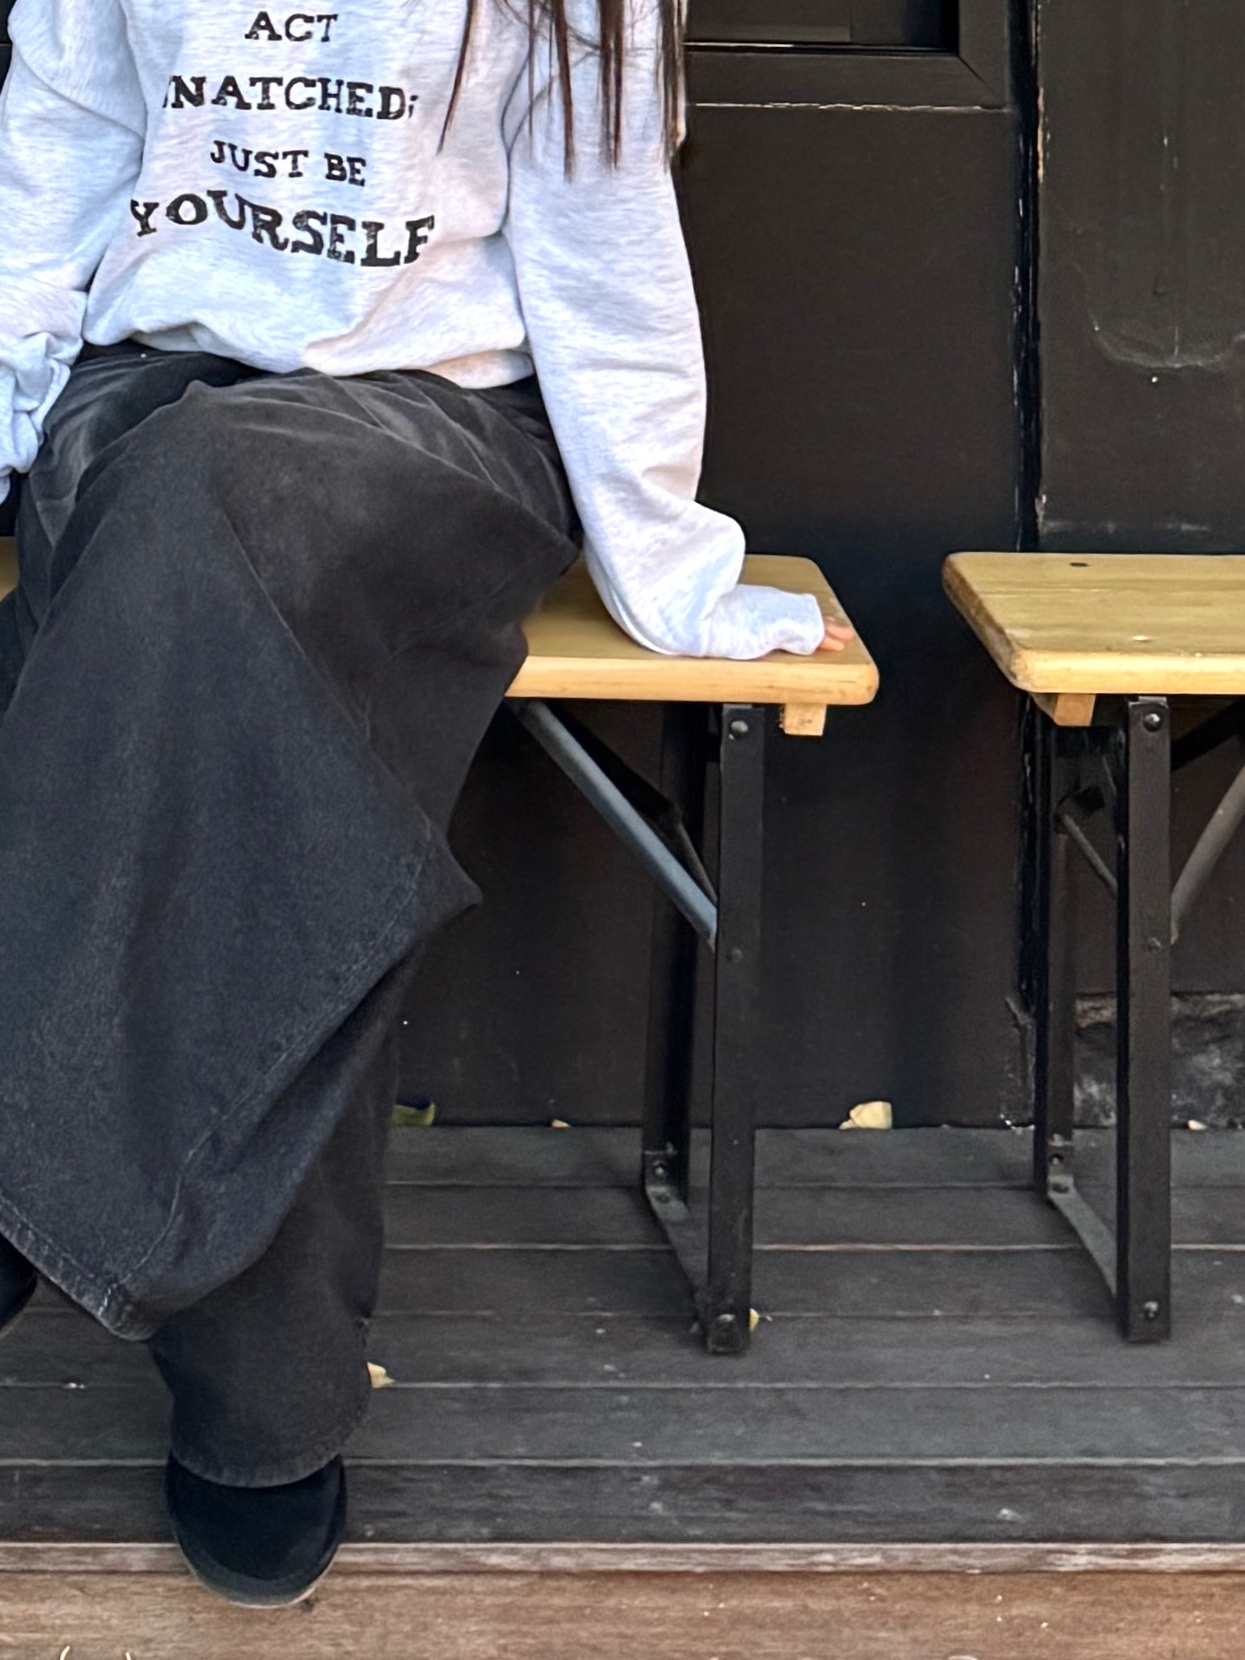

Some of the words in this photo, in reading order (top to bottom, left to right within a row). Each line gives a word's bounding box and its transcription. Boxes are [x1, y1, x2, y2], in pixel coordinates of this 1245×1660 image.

[244, 11, 338, 43] ACT
[162, 75, 419, 120] NATCHED;
[210, 139, 309, 179] JUST
[325, 152, 367, 187] BE
[130, 189, 435, 267] YOURSELF
